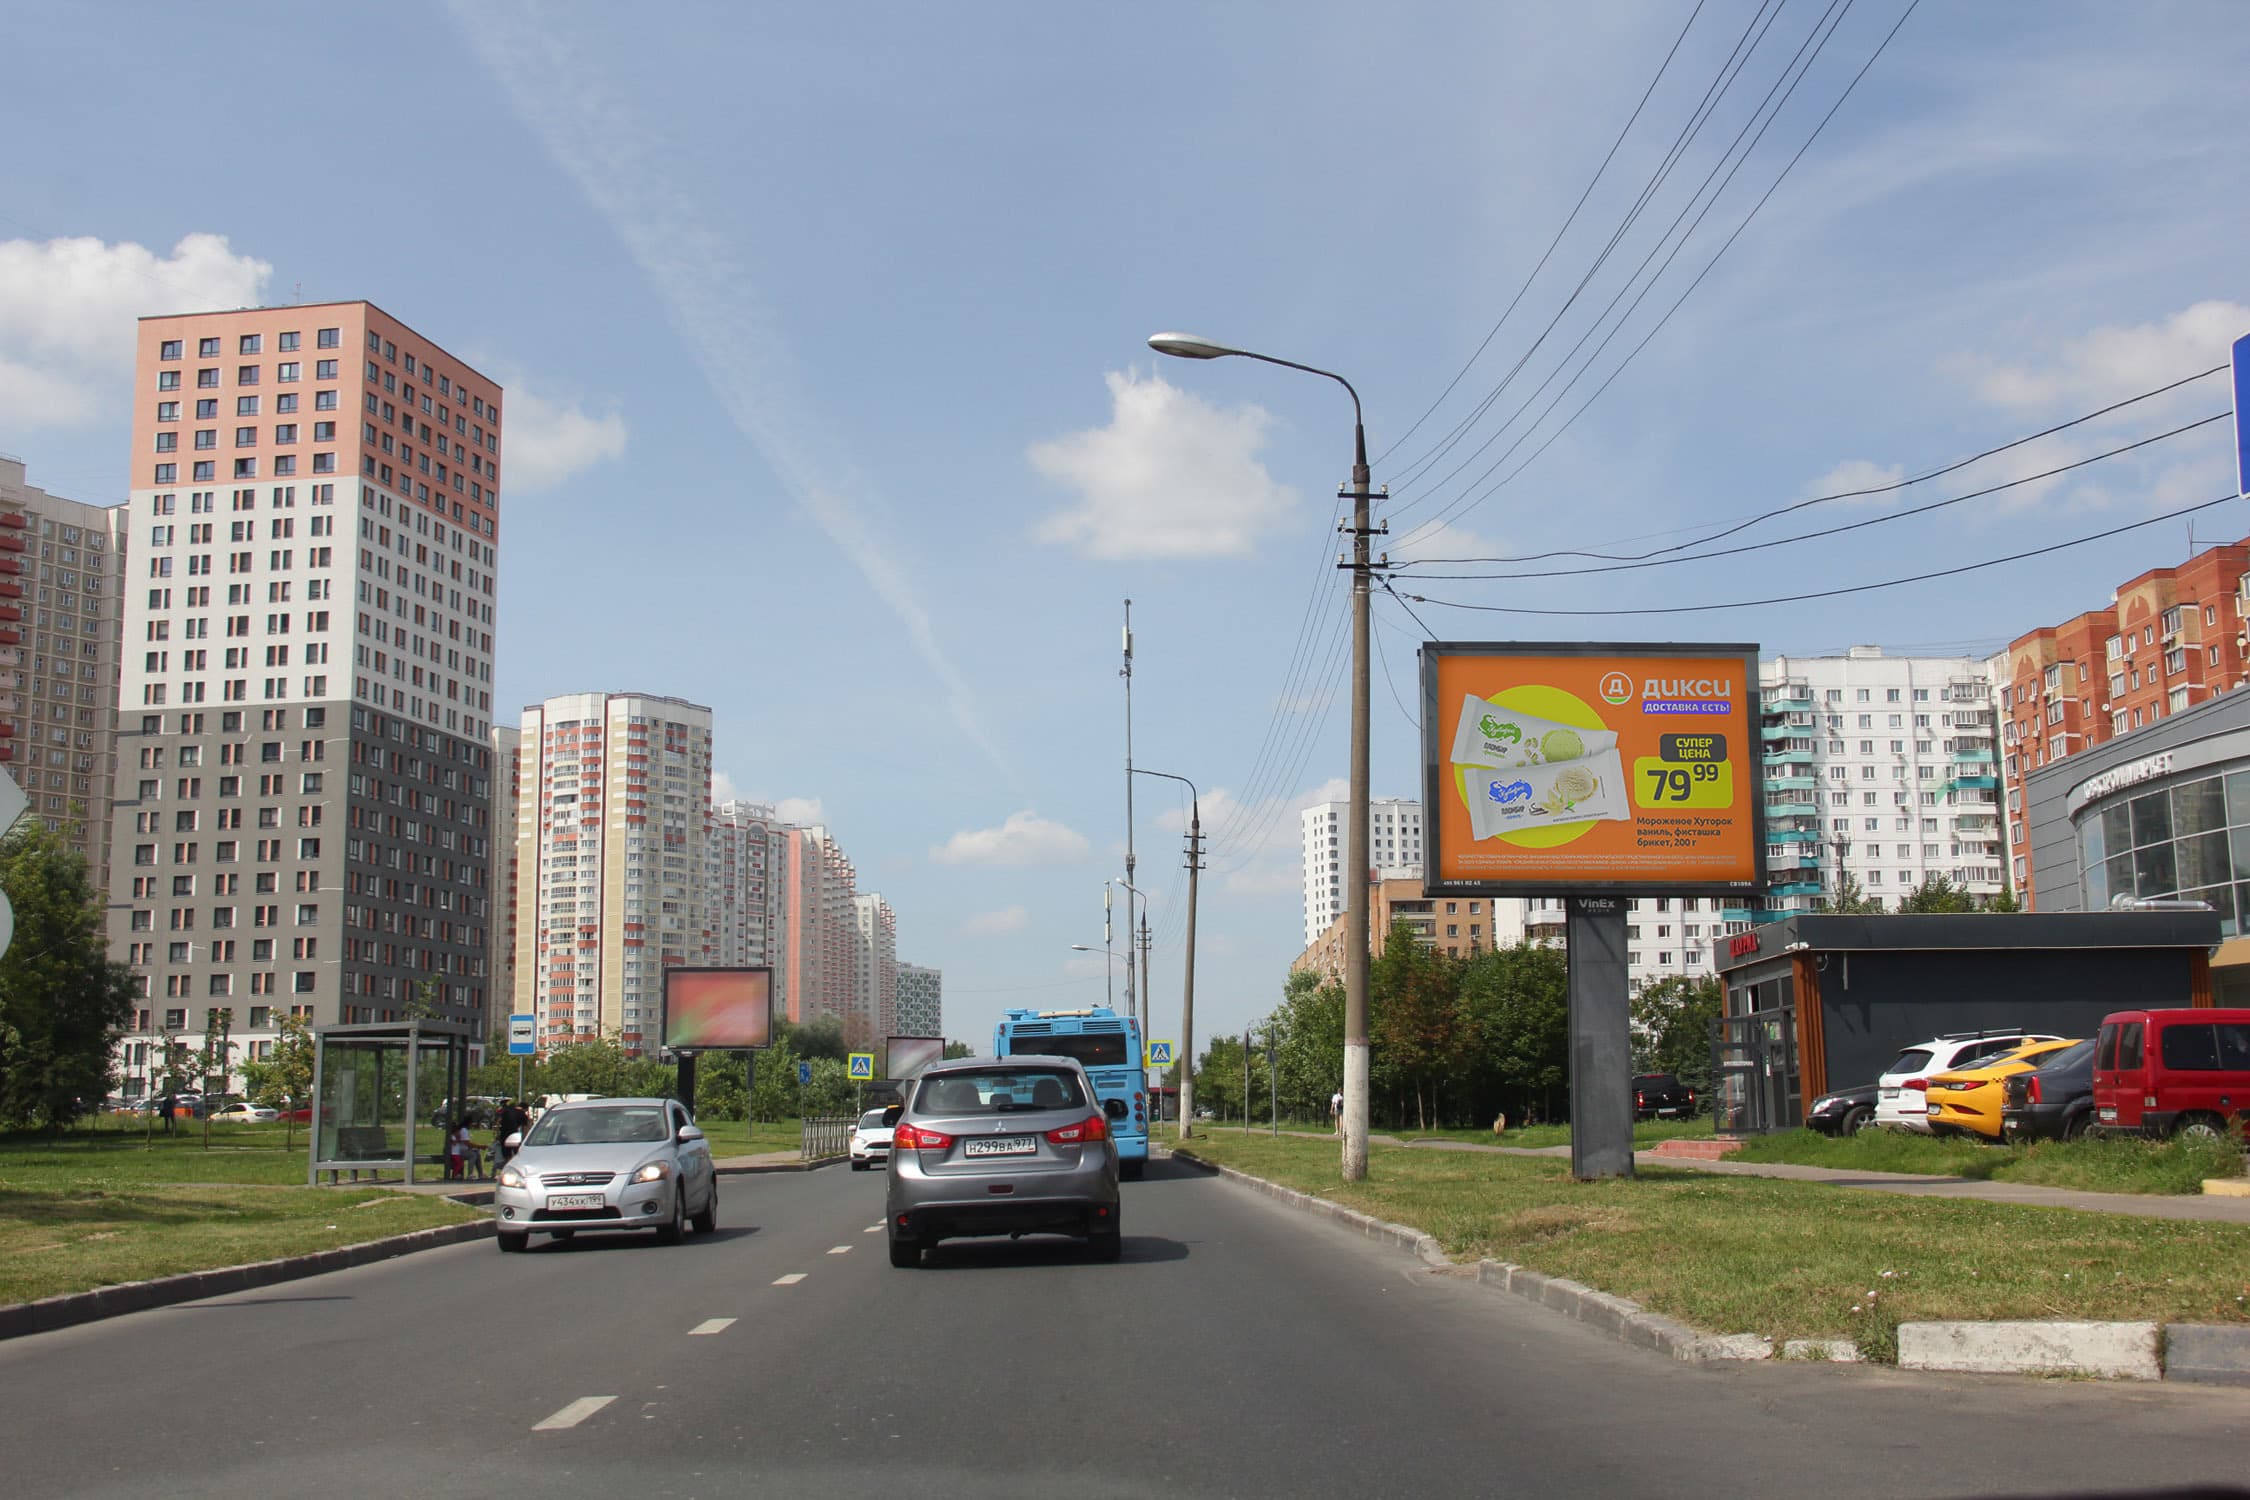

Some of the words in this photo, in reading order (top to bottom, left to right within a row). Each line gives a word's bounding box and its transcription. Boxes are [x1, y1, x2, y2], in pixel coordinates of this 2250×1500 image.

[1642, 679, 1730, 699] ДИКСИ
[1644, 703, 1699, 713] ДОСТАВКА
[1701, 704, 1730, 713] ЕСТЬ!
[1675, 738, 1713, 748] СУПЕР
[1679, 749, 1711, 760] ЦЕНА
[1646, 769, 1691, 801] 79
[1693, 764, 1719, 781] 99
[1636, 817, 1692, 826] Мороженое
[1694, 817, 1733, 827] Хуторок
[1637, 828, 1673, 837] ваниль,
[1674, 827, 1721, 838] фисташка
[1637, 838, 1673, 848] брикет,
[1674, 839, 1691, 847] 200
[1578, 899, 1615, 909] VinEx
